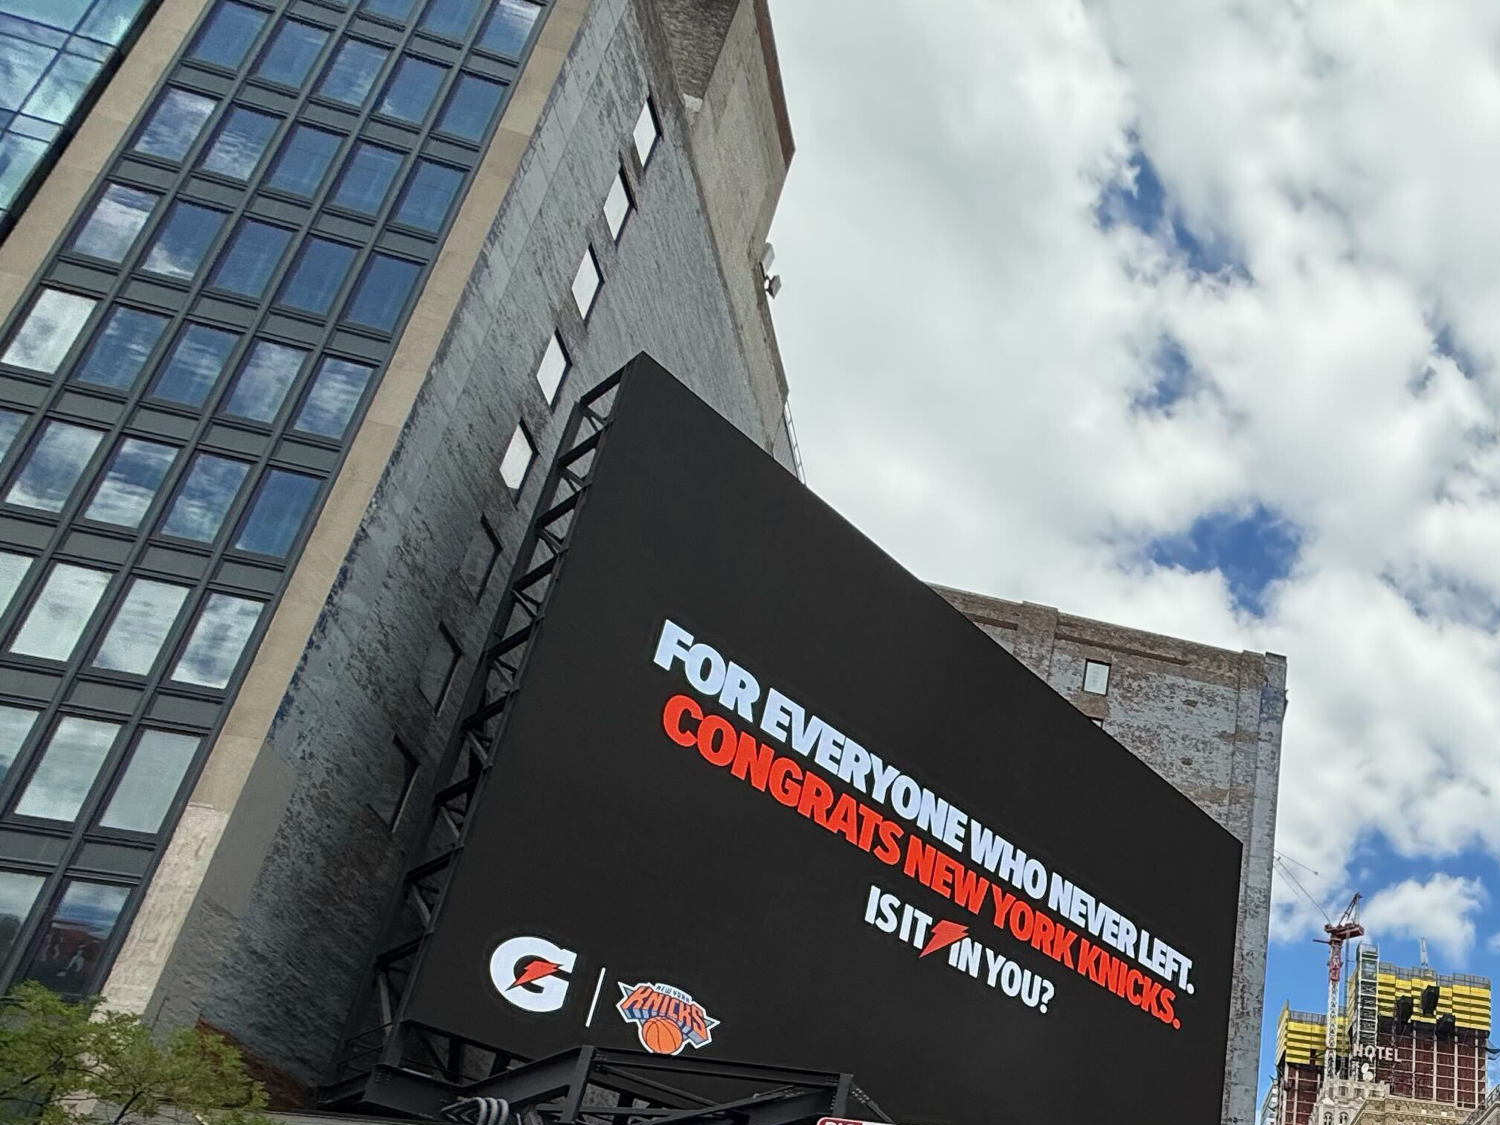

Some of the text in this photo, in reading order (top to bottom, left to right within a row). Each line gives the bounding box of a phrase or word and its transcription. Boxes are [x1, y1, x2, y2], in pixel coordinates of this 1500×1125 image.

[654, 619, 1195, 994] FOR EVERYONE WHO NEVER LEFT.
[663, 695, 1181, 1030] CONGRATS NEW YORK KNICKS.
[656, 985, 690, 1003] NEW YORK
[864, 885, 1055, 1014] IS IT IN YOU?
[620, 985, 709, 1042] KNICKS
[1353, 1044, 1403, 1062] HOTEL
